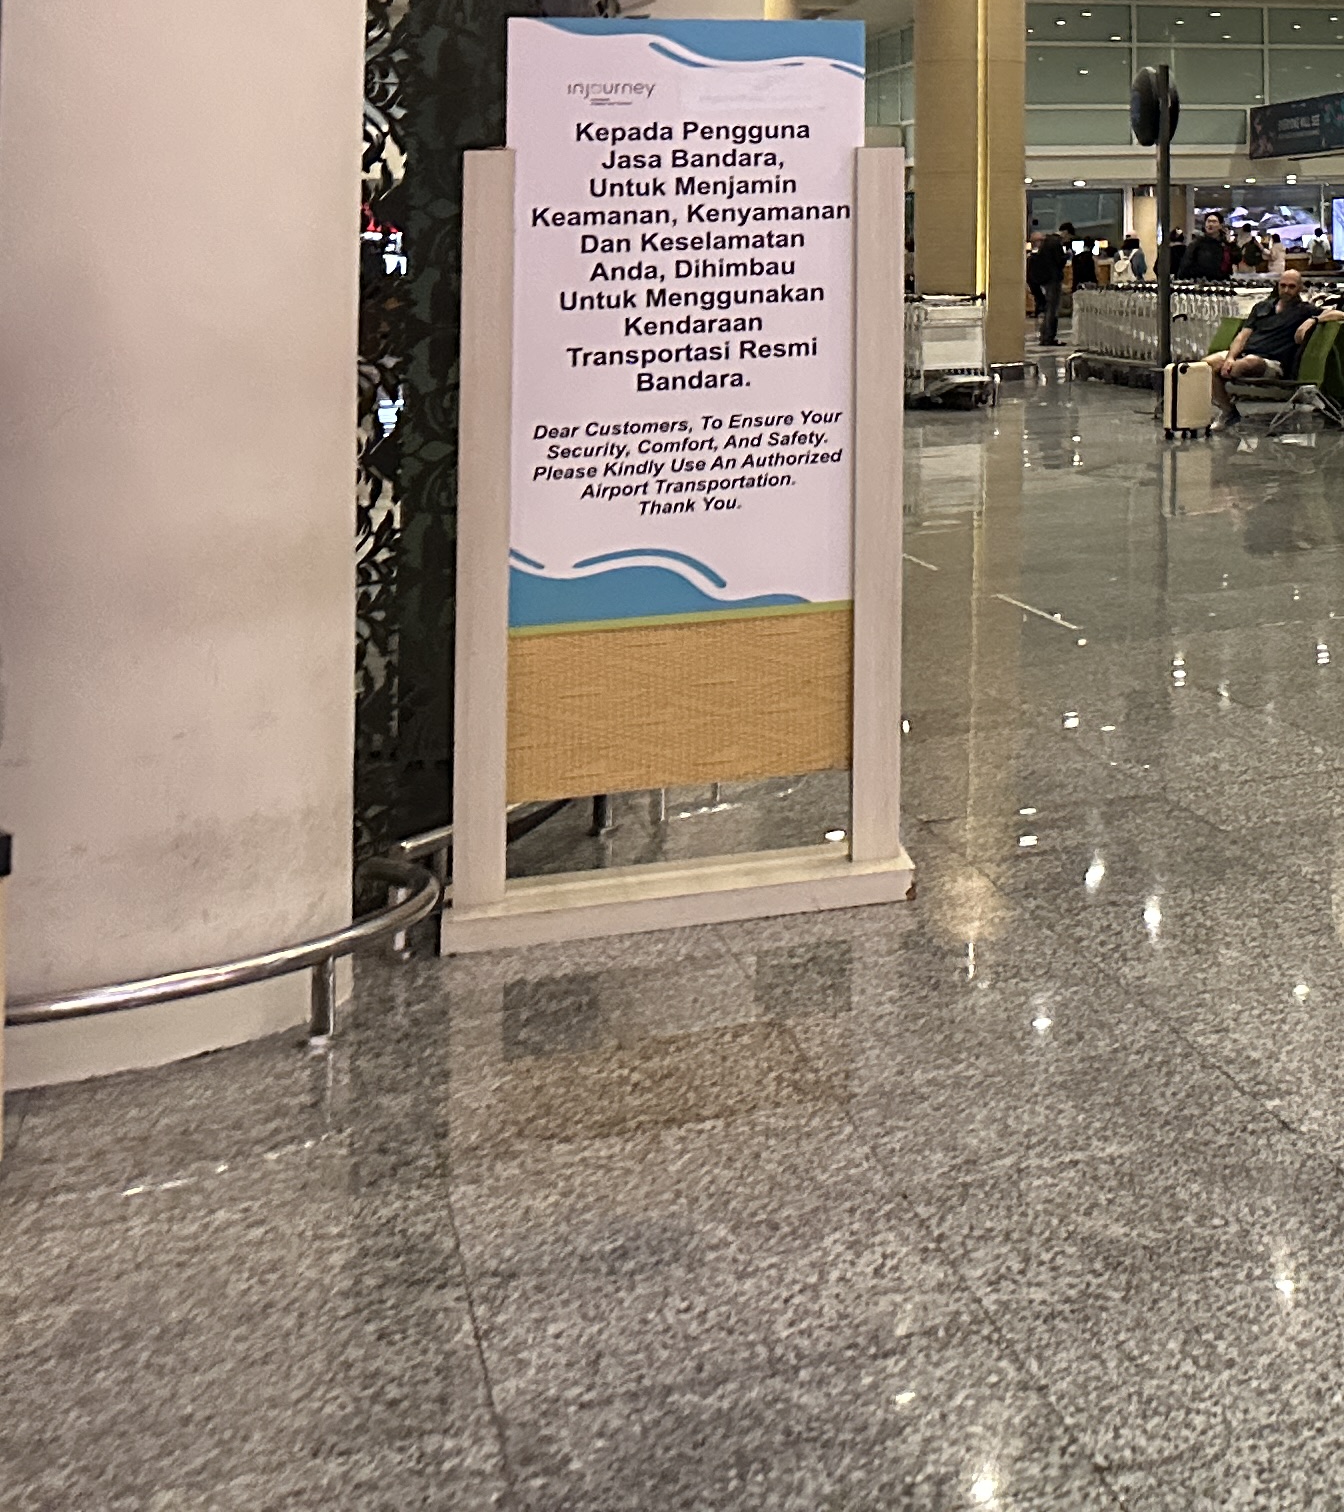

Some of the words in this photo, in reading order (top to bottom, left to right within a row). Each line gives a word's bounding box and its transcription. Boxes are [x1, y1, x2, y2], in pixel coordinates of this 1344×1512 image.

[575, 121, 674, 147] Kepada
[682, 120, 811, 145] Pengguna
[600, 149, 662, 170] Jasa
[671, 147, 785, 171] Bandara,
[589, 176, 667, 199] Untuk
[674, 174, 797, 200] Menjamin
[531, 206, 678, 228] Keamanan,
[686, 203, 851, 228] Kenyamanan
[580, 233, 632, 255] Dan
[640, 229, 805, 253] Keselamatan
[589, 260, 666, 283] Anda,
[674, 256, 796, 280] Dihimbau
[559, 289, 638, 312] Untuk
[645, 283, 825, 312] Menggunakan
[624, 314, 763, 337] Kendaraan
[565, 340, 731, 370] Transportasi
[738, 336, 818, 360] Resmi
[636, 369, 751, 393] Bandara.
[532, 424, 581, 441] Dear
[584, 420, 693, 438] Customers,
[701, 414, 724, 431] To
[727, 413, 795, 430] Ensure
[800, 409, 844, 426] Your
[546, 441, 631, 461] Security,
[637, 436, 719, 455] Comfort,
[722, 432, 764, 450] And
[767, 430, 829, 449] Safety.
[532, 465, 598, 482] Please
[602, 459, 666, 478] Kindly
[670, 457, 707, 474] Use
[709, 455, 737, 472] An
[740, 447, 844, 469] Authorized
[579, 480, 650, 502] Airport
[655, 472, 796, 495] Transportation.
[638, 497, 696, 517] Thank
[702, 495, 742, 512] You.
